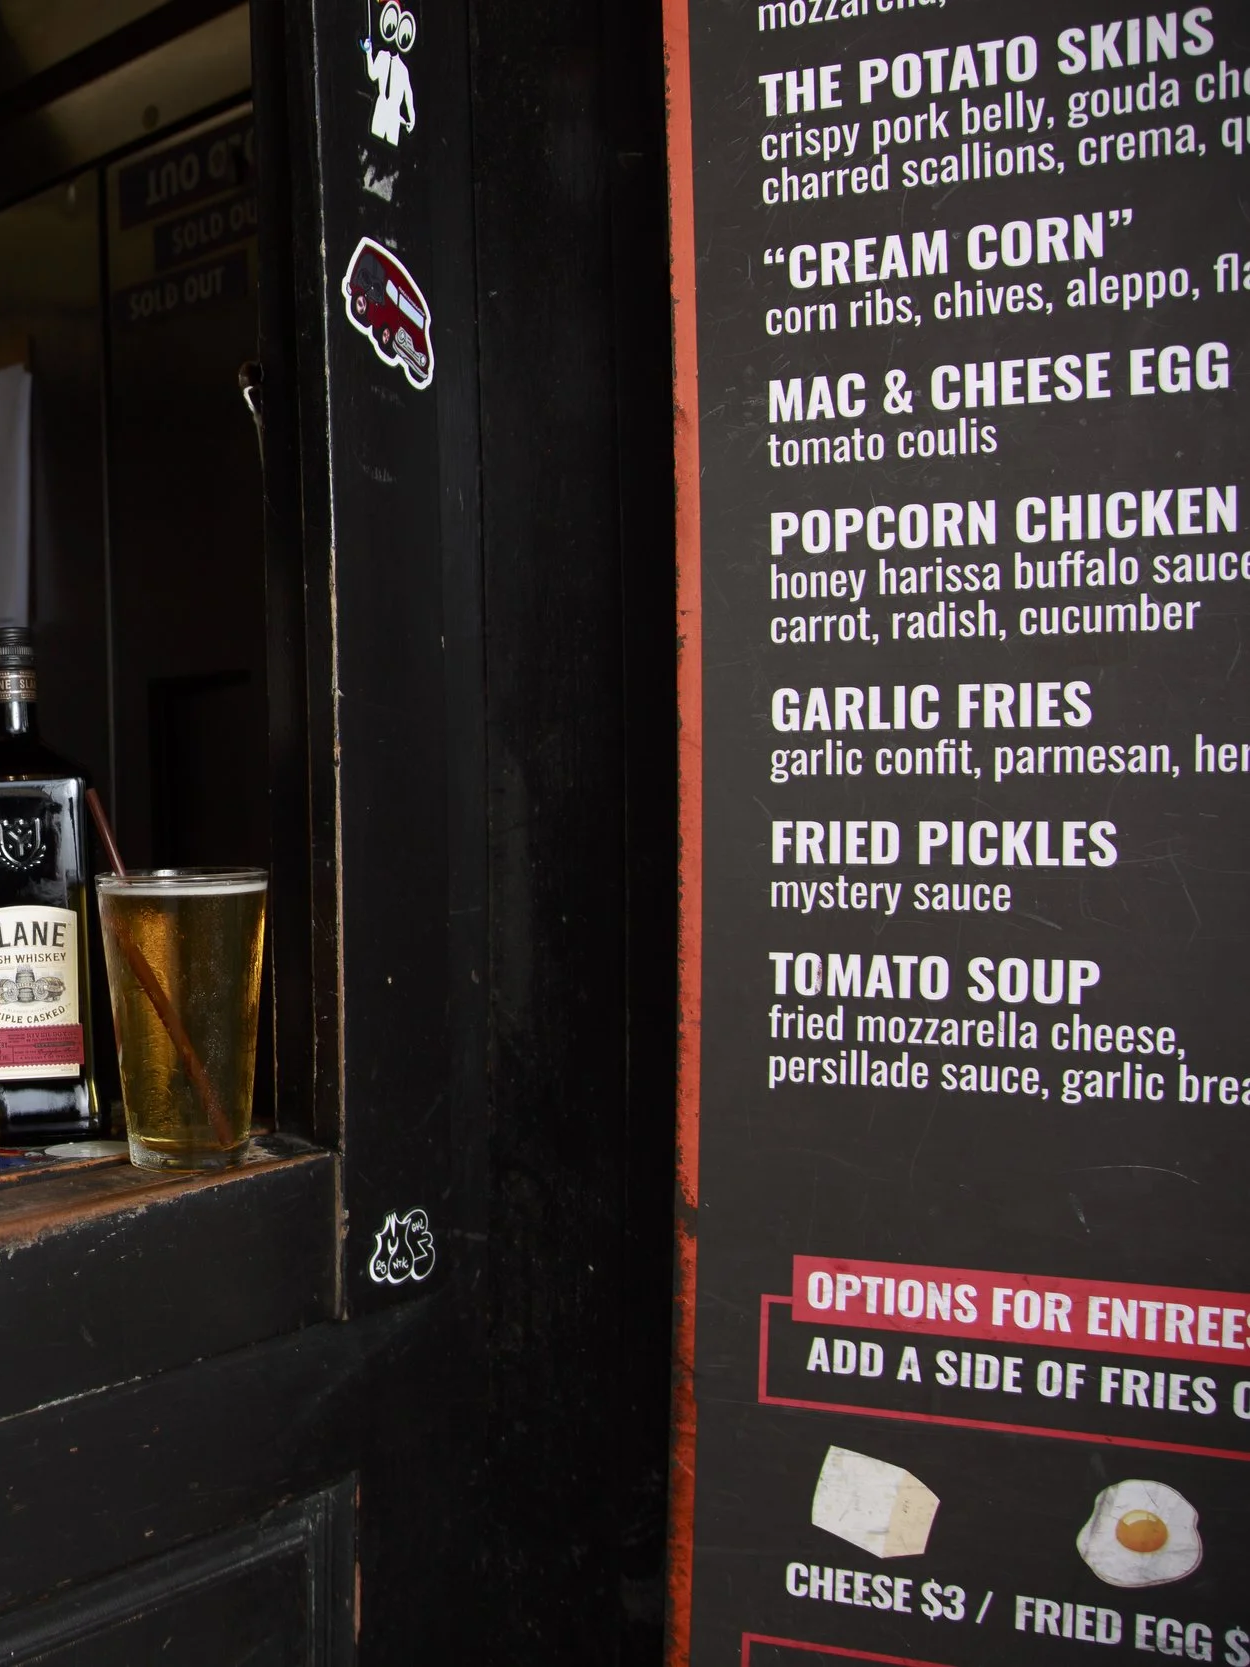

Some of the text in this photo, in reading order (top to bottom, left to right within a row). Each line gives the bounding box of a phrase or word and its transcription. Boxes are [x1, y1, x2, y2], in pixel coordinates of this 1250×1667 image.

[758, 6, 1216, 117] THE POTATO SKINS
[761, 122, 860, 162] crispy
[872, 102, 950, 155] pork
[961, 90, 1055, 136] belly,
[1067, 71, 1181, 129] gouda
[761, 153, 890, 205] charred
[901, 141, 1065, 188] scallions,
[1078, 124, 1206, 166] crema,
[171, 211, 223, 256] SOLD
[129, 265, 226, 322] SOLD OUT
[765, 302, 837, 336] corn
[849, 288, 922, 328] ribs,
[933, 279, 1053, 320] chives,
[1066, 266, 1200, 311] aleppo,
[768, 341, 1229, 424] MAC & CHEESE EGG
[767, 417, 998, 468] tomato coulis
[770, 485, 1237, 556] POPCORN CHICKEN
[770, 563, 867, 603] honey
[878, 556, 1001, 596] harissa
[1014, 547, 1139, 590] buffalo
[770, 592, 1202, 646] carrot, radish, cucumber
[771, 680, 1092, 733] GARLIC FRIES
[769, 738, 863, 784] garlic
[875, 738, 982, 780] confit,
[994, 744, 1180, 783] parmesan,
[771, 820, 1118, 868] FRIED PICKLES
[770, 874, 1011, 916] mystery sauce
[14, 952, 67, 964] WHISKEY
[768, 951, 1101, 1005] TOMATO SOUP
[26, 1005, 66, 1024] CASKED
[768, 1003, 1185, 1061] fried mozzarella cheese,
[768, 1049, 929, 1089] persillade
[940, 1063, 1049, 1100] sauce,
[1061, 1061, 1165, 1105] garlic
[807, 1270, 1250, 1350] OPTIONS FOR ENTREE
[806, 1336, 884, 1378] ADD
[896, 1346, 922, 1383] A
[935, 1349, 1023, 1394] SIDE
[1036, 1360, 1086, 1400] OF
[1100, 1366, 1217, 1415] FRIES
[785, 1562, 913, 1613] CHEESE
[920, 1578, 966, 1621] $3
[1015, 1595, 1122, 1645] FRIED
[1135, 1613, 1212, 1662] EGG
